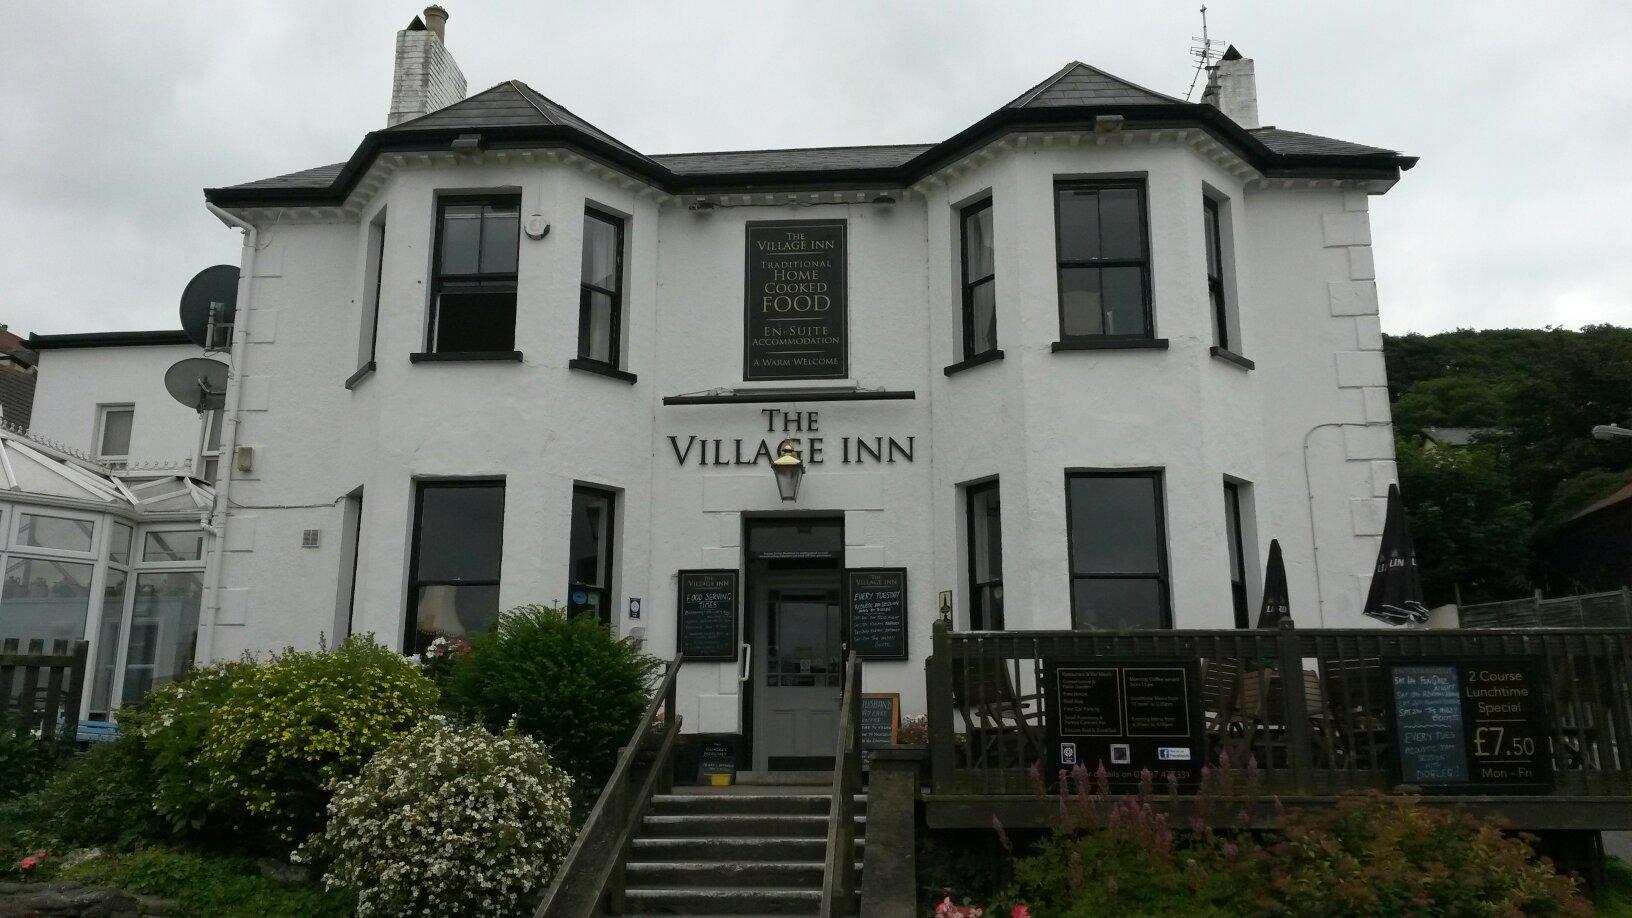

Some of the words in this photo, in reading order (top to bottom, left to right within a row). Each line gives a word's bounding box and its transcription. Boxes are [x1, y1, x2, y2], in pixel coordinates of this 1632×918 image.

[757, 241, 807, 250] VILLAGE
[811, 240, 835, 250] INN
[761, 260, 832, 269] TRADITIONAL
[774, 270, 819, 280] HOME
[764, 282, 828, 294] COOKED
[762, 295, 831, 312] FOOD
[764, 326, 829, 336] EN-SUITE
[752, 336, 840, 346] ACCOMMODATION
[762, 358, 791, 366] WARM
[794, 358, 838, 366] WELCOME
[761, 408, 819, 432] THE
[842, 436, 915, 464] INN
[686, 594, 703, 602] FOOD
[705, 592, 732, 601] SERVING
[1468, 670, 1476, 682] 2
[1480, 670, 1523, 682] Course
[1466, 686, 1529, 697] Lunchtime
[1478, 701, 1521, 716] Special
[1474, 727, 1535, 756] £7.50
[1482, 768, 1507, 778] Mon
